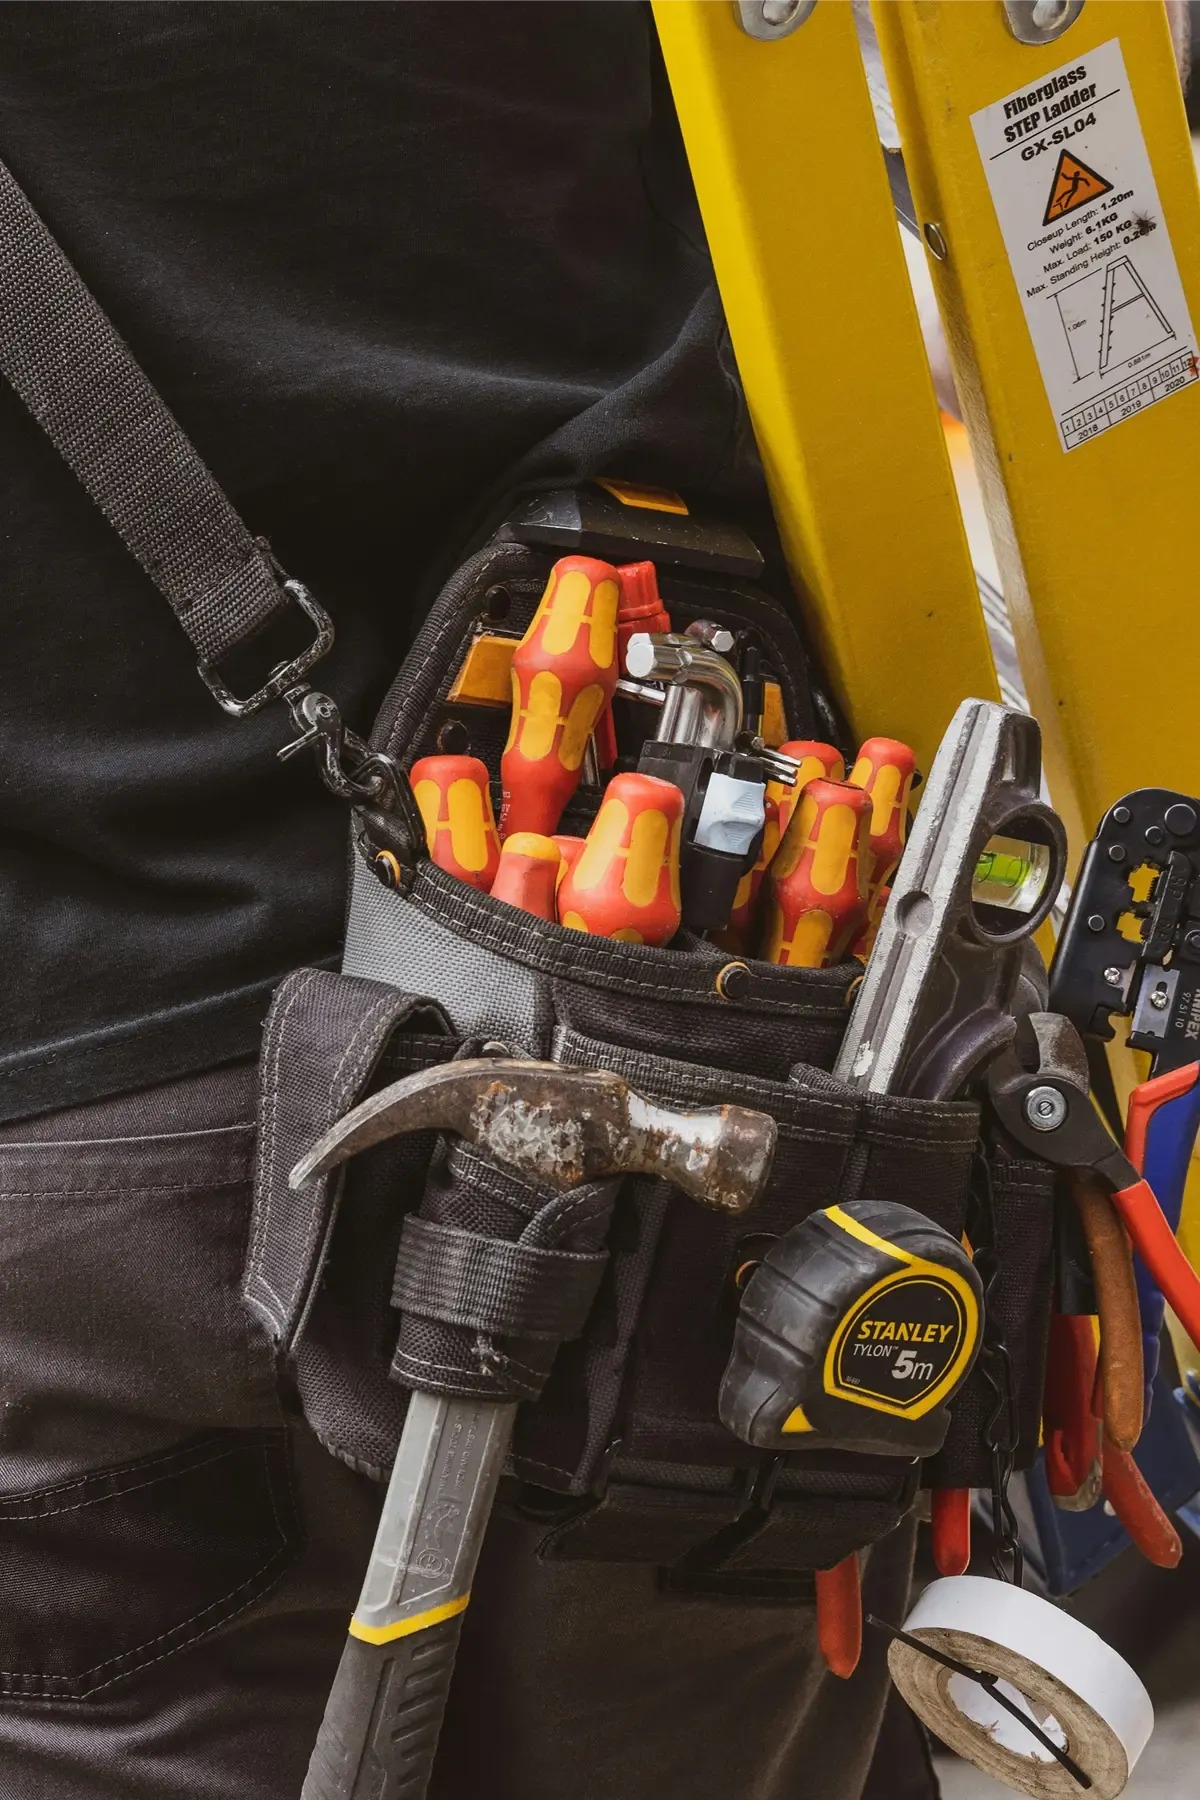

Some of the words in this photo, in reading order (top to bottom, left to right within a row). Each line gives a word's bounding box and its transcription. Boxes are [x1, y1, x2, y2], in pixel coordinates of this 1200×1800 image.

[1003, 66, 1086, 120] Fiberglass
[1004, 112, 1040, 142] STEP
[1044, 83, 1096, 122] Ladder
[1021, 112, 1096, 161] GX-SL04
[1027, 228, 1064, 251] Closeup
[1066, 208, 1099, 230] Length:
[1100, 190, 1134, 210] 1.20m
[1043, 260, 1064, 274] Max.
[1066, 244, 1092, 260] Load:
[1094, 232, 1113, 246] 150
[1116, 220, 1132, 234] KG
[1049, 232, 1083, 254] Weight:
[1085, 212, 1118, 235] 6.1KG
[1026, 283, 1048, 298] Max.
[1050, 260, 1088, 285] Standing
[1090, 242, 1122, 263] Height:
[1161, 370, 1170, 379] 10
[1172, 364, 1180, 373] 11
[1078, 424, 1099, 440] 2018
[1121, 400, 1141, 416] 2019
[1164, 376, 1185, 392] 2020
[857, 1320, 953, 1343] STANLEY
